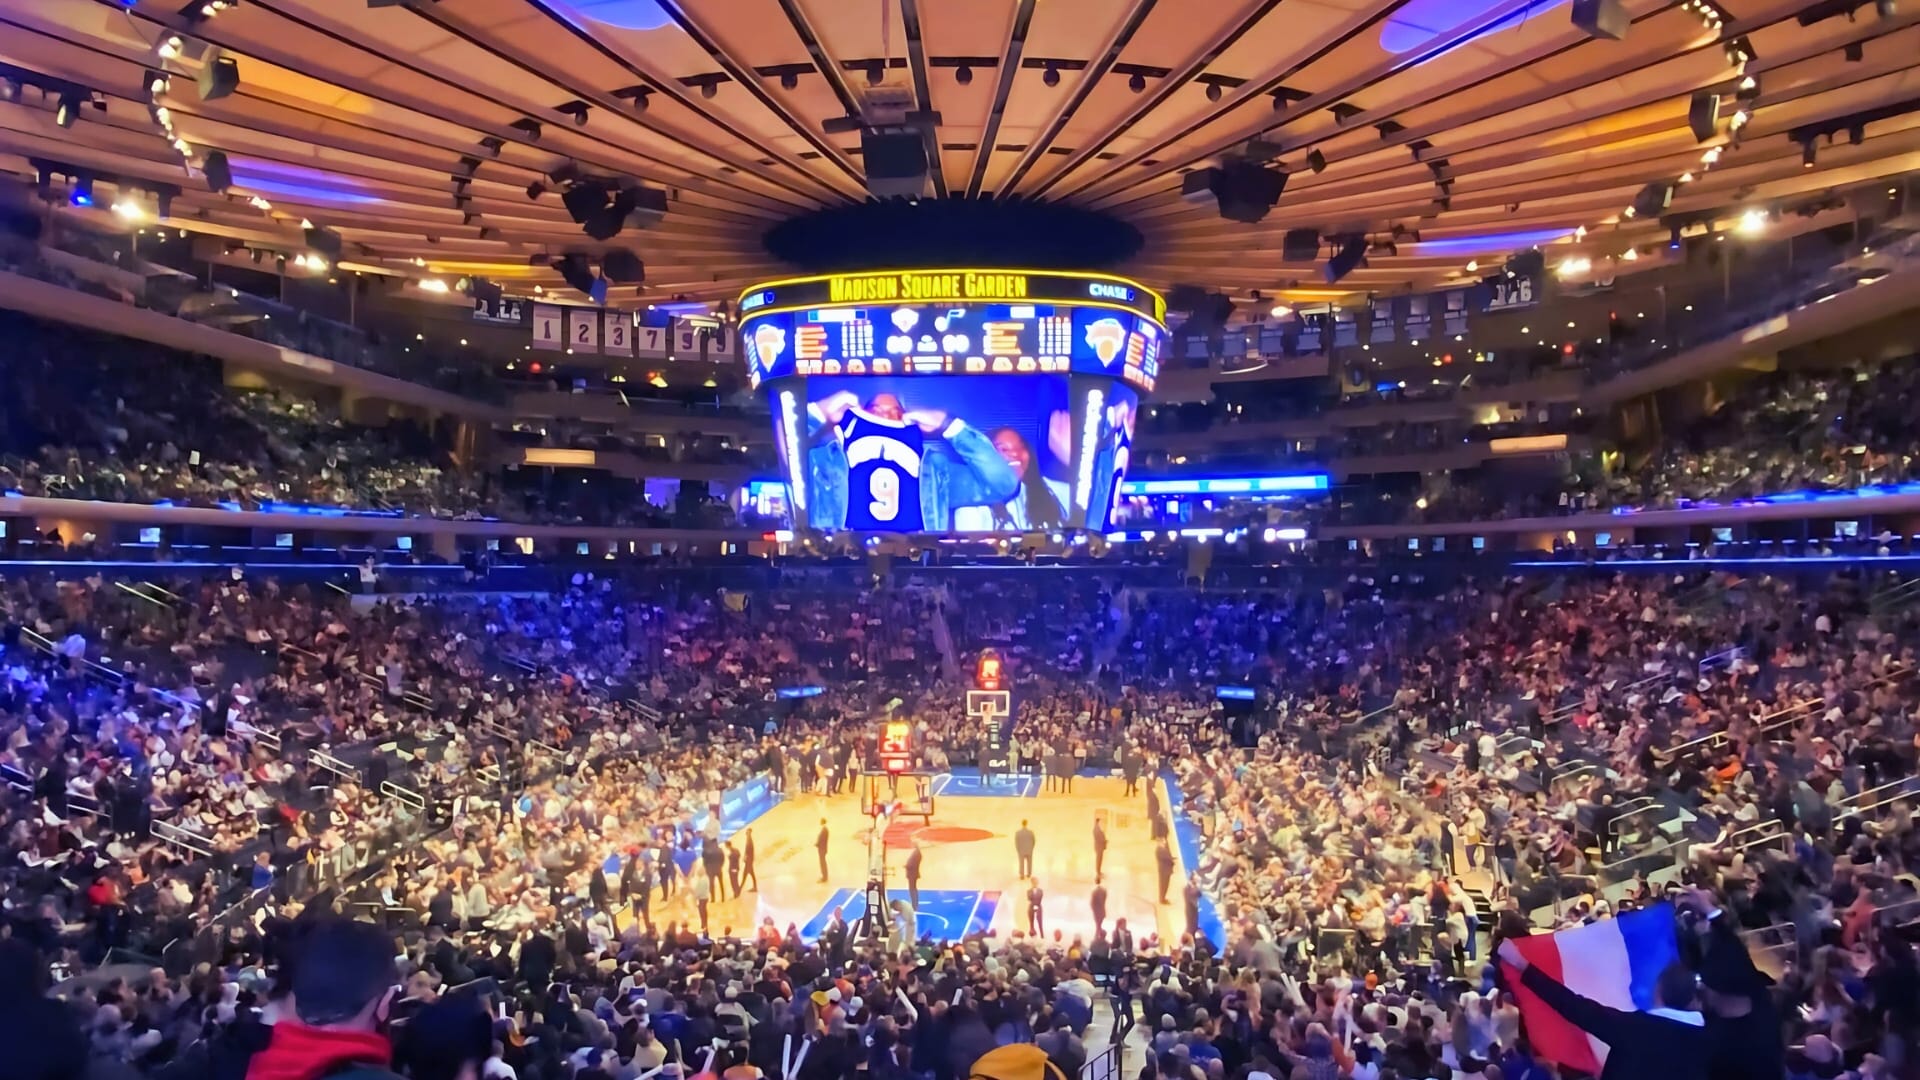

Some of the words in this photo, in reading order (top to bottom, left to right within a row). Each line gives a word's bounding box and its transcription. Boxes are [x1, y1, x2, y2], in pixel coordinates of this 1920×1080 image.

[831, 277, 897, 301] MADISON
[902, 274, 960, 298] SQUARE
[965, 273, 1027, 297] GARDEN
[543, 319, 551, 339] 1
[578, 323, 589, 343] 2
[613, 327, 623, 346] 3
[646, 329, 658, 349] 7
[682, 332, 693, 350] 9
[869, 467, 900, 521] 9
